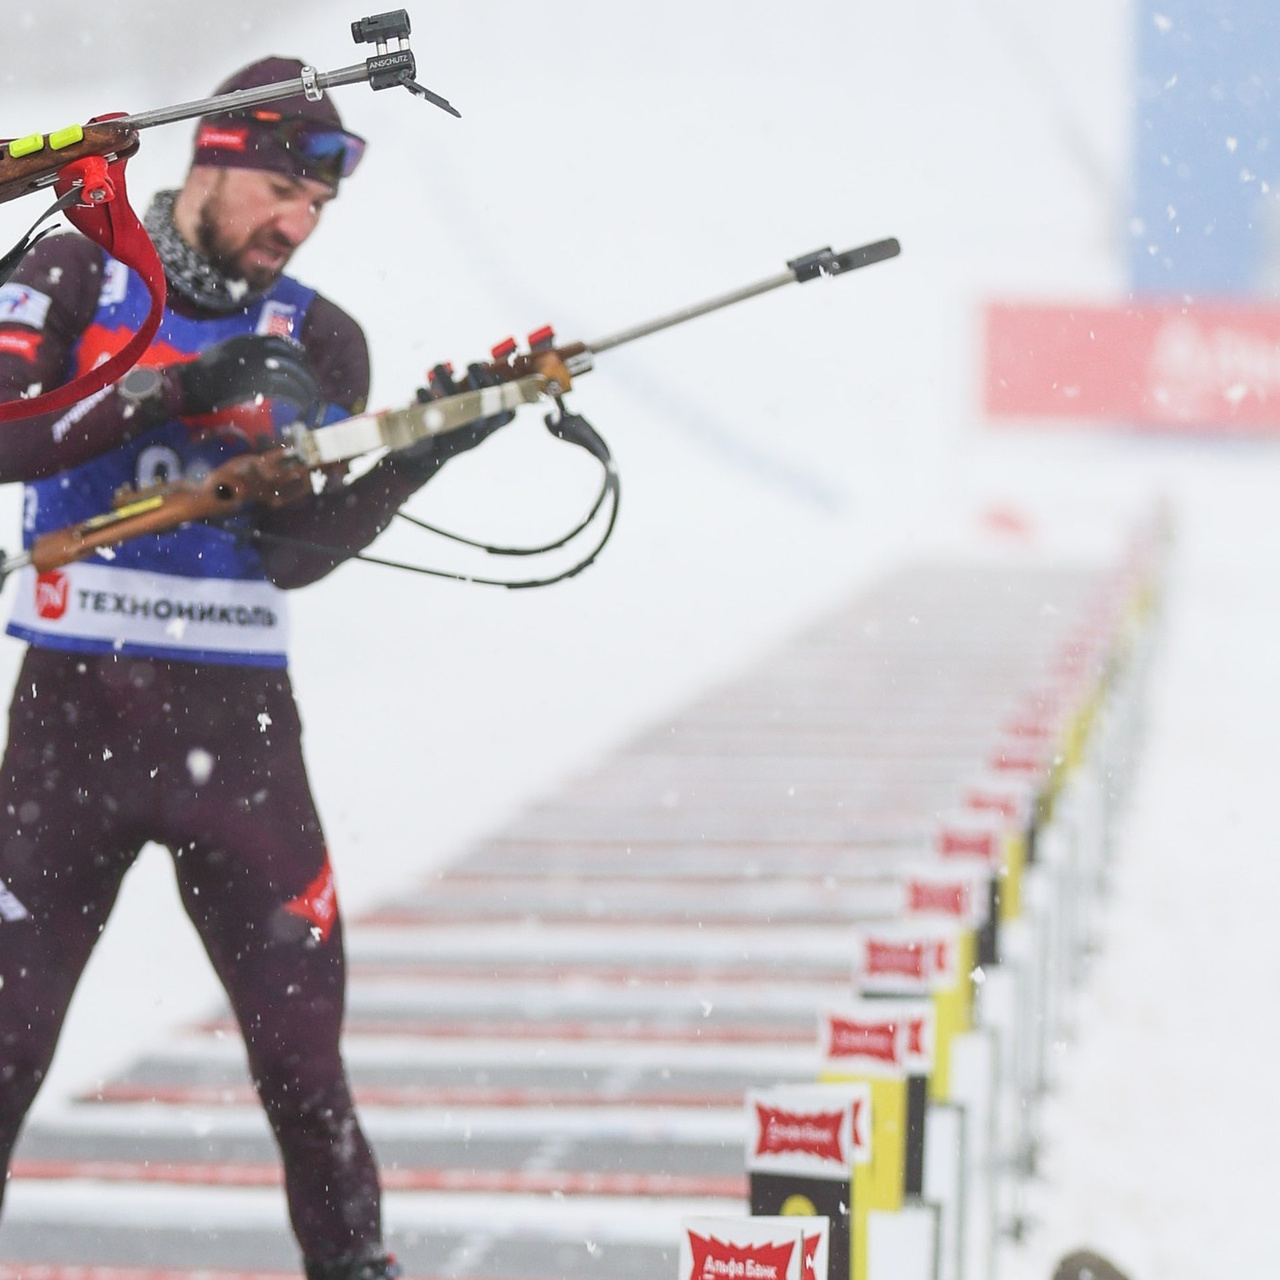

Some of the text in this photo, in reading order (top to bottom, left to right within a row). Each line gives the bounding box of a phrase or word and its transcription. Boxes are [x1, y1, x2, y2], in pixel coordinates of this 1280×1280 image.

[369, 55, 409, 69] ANSCHUTZ
[78, 589, 278, 628] ТЕХНОНИКОЛЬ
[702, 1254, 744, 1280] Альфа
[745, 1259, 777, 1280] Банк
